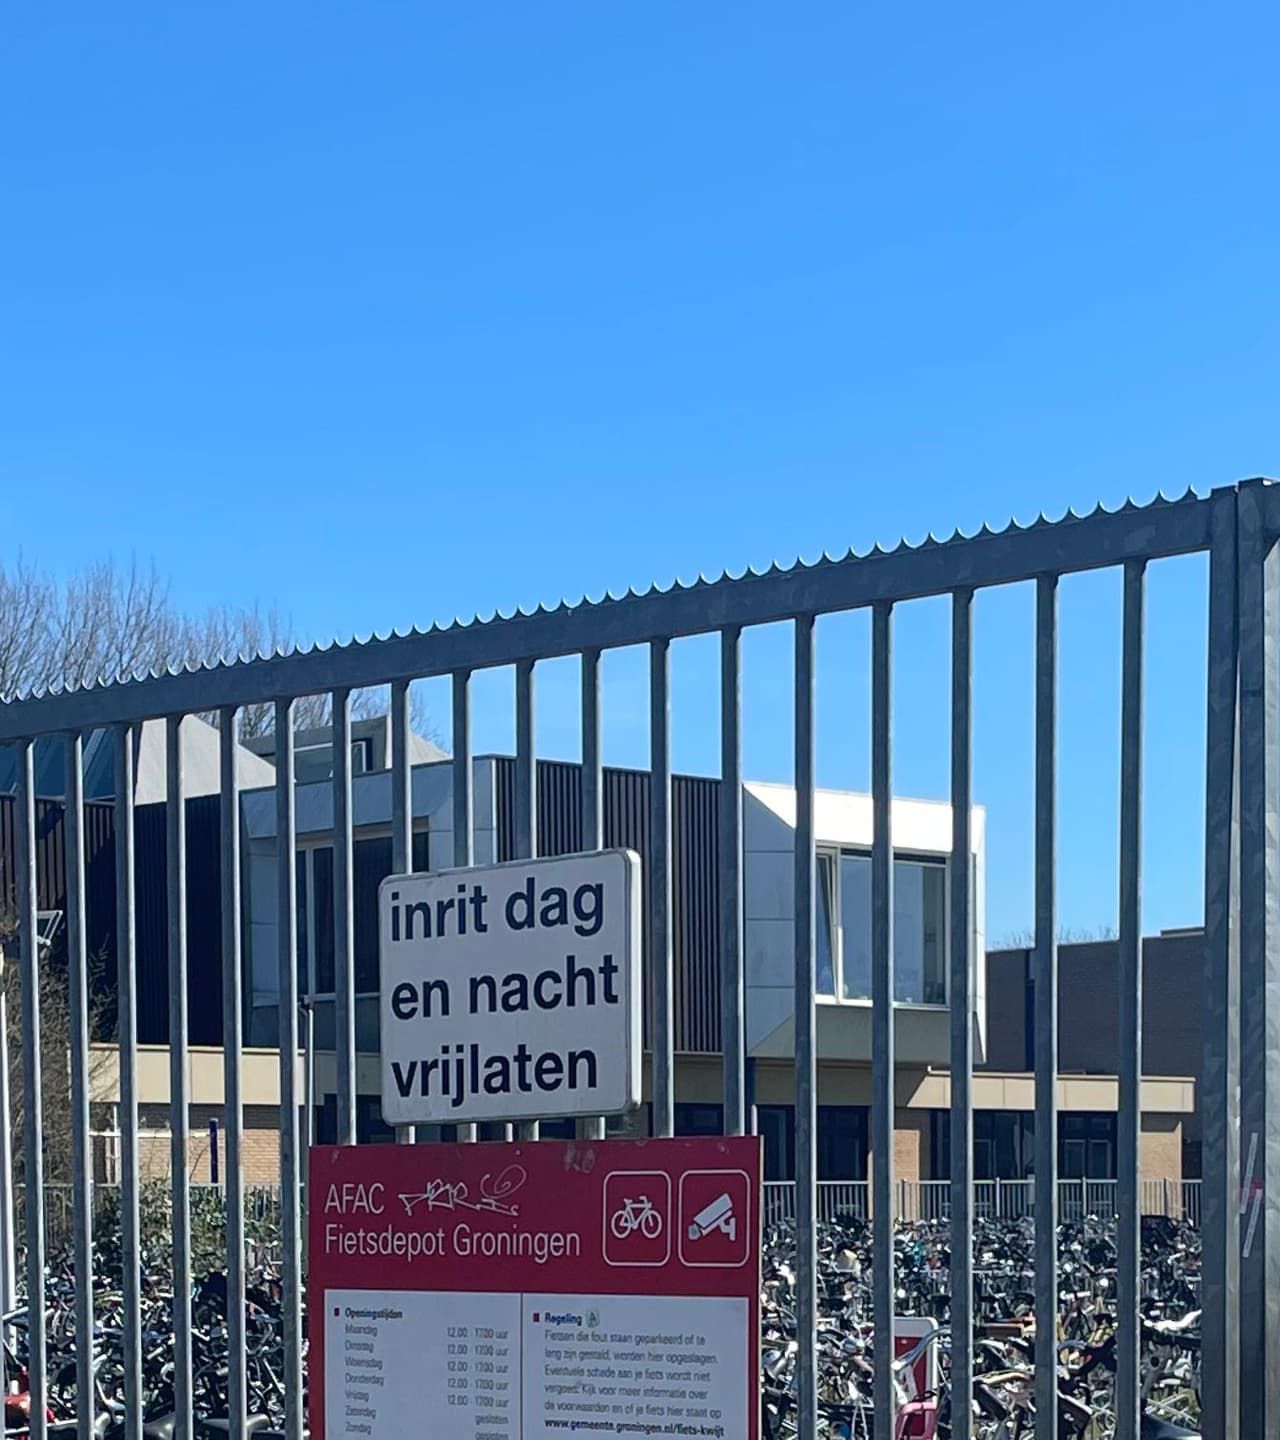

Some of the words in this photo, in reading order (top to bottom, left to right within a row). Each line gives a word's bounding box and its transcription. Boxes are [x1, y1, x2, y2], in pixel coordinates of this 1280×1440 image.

[391, 884, 488, 941] inrit
[505, 877, 604, 937] dag
[392, 979, 450, 1020] en
[469, 955, 619, 1014] nacht
[391, 1044, 597, 1107] vrijlaten
[324, 1183, 385, 1214] AFAC
[325, 1224, 445, 1262] Fietsdepot
[453, 1224, 581, 1264] Groningen
[345, 1307, 403, 1320] Openingstijden
[545, 1312, 582, 1326] Regeling
[345, 1324, 378, 1337] Maandag
[447, 1327, 468, 1338] 12.00
[496, 1331, 508, 1339] uur
[545, 1330, 575, 1342] Fietsen
[577, 1331, 589, 1342] die
[591, 1331, 607, 1342] fout
[610, 1334, 632, 1343] staan
[635, 1334, 683, 1346] geparkeerd
[685, 1335, 694, 1344] of
[696, 1336, 705, 1345] te
[447, 1344, 468, 1355] 12.00
[496, 1348, 508, 1356] uur
[545, 1349, 561, 1361] lang
[564, 1349, 577, 1361] zijn
[614, 1352, 645, 1361] worden
[648, 1352, 663, 1362] hier
[666, 1353, 717, 1365] opgeslagen.
[345, 1356, 383, 1370] Woensdag
[447, 1361, 468, 1372] 12.00
[496, 1365, 508, 1374] uur
[345, 1373, 384, 1386] Donderdag
[545, 1364, 584, 1376] Eventuele
[587, 1367, 615, 1378] schade
[618, 1370, 632, 1379] aan
[635, 1369, 643, 1381] je
[645, 1369, 663, 1380] fiets
[666, 1370, 691, 1381] wordt
[694, 1371, 710, 1382] niet
[447, 1378, 468, 1389] 12.00
[496, 1382, 508, 1390] uur
[345, 1390, 369, 1402] Vrijdag
[582, 1383, 596, 1396] Kijk
[598, 1387, 616, 1396] voor
[620, 1388, 641, 1397] meer
[643, 1387, 686, 1399] informatie
[689, 1391, 708, 1400] over
[447, 1395, 468, 1406] 12.00
[496, 1399, 508, 1407] uur
[545, 1400, 555, 1410] de
[557, 1401, 609, 1412] voorwaarden
[612, 1404, 623, 1413] en
[625, 1404, 634, 1415] of
[636, 1405, 644, 1417] je
[646, 1405, 664, 1416] fiets
[667, 1406, 684, 1416] hier
[686, 1408, 707, 1418] staat
[709, 1409, 722, 1420] op
[475, 1414, 508, 1425] gesloten
[345, 1422, 372, 1435] Zondag
